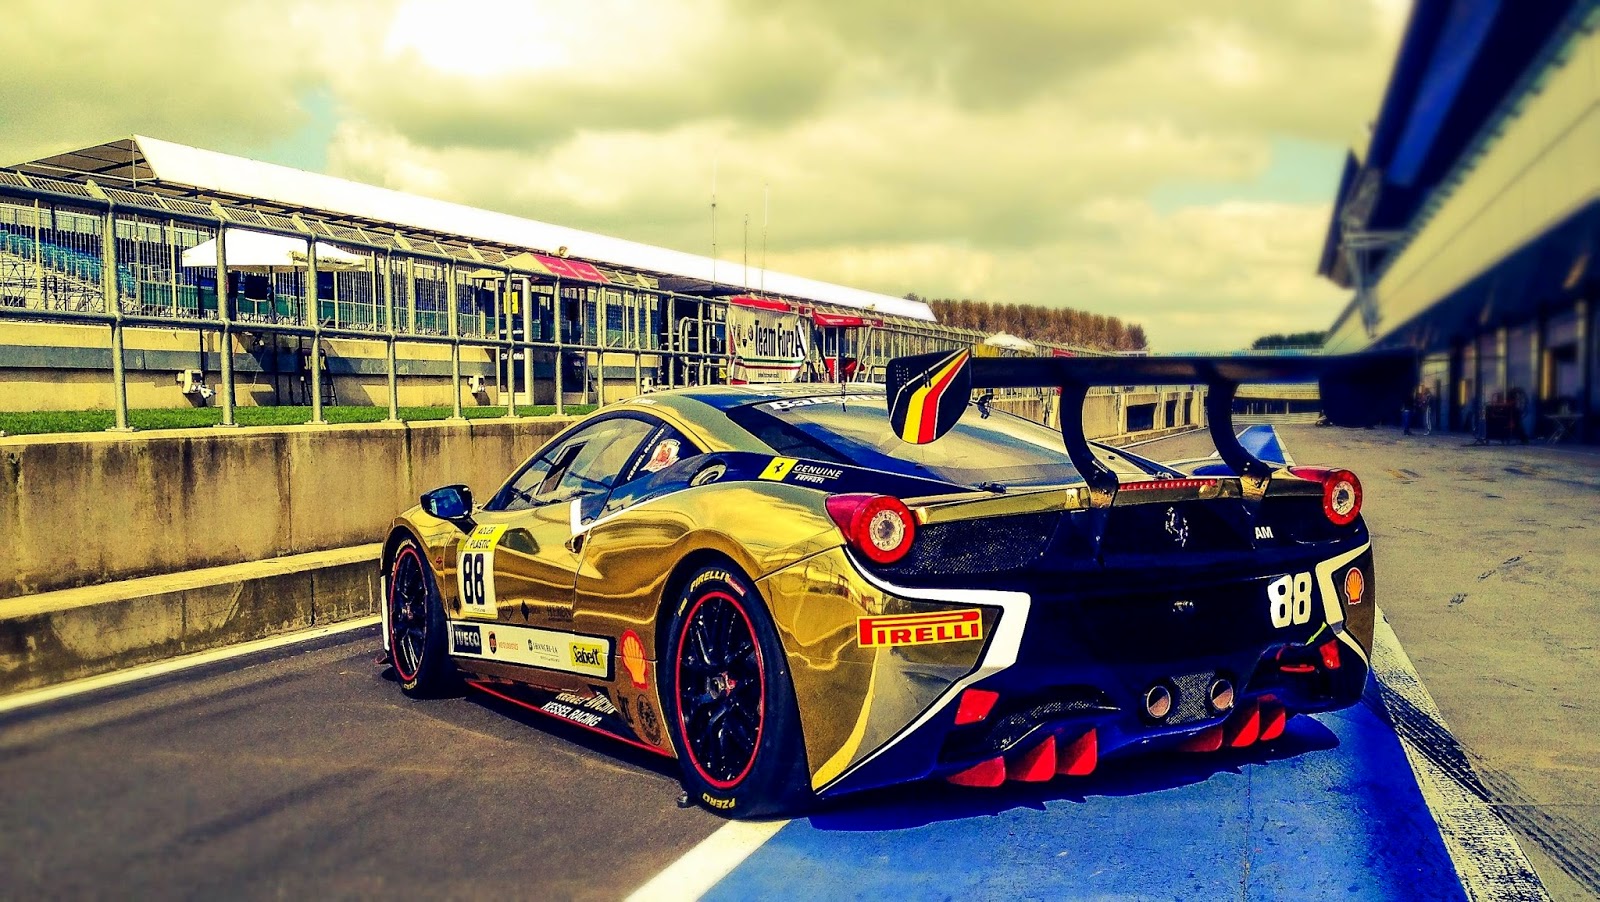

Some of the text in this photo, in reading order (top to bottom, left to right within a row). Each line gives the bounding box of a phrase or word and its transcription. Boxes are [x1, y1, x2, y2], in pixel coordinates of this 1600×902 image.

[755, 320, 776, 357] Team
[643, 428, 665, 454] RACING
[793, 464, 844, 478] GENUINE
[469, 539, 491, 549] PLASTIC
[1254, 526, 1274, 539] AM
[463, 553, 485, 605] 88
[690, 570, 726, 593] PIRELLI
[1267, 571, 1312, 628] 88
[455, 631, 480, 647] IVECO
[860, 611, 980, 645] PIRELLI
[540, 701, 573, 718] KESSEL
[567, 709, 602, 727] RACING
[702, 792, 736, 809] PZERO
